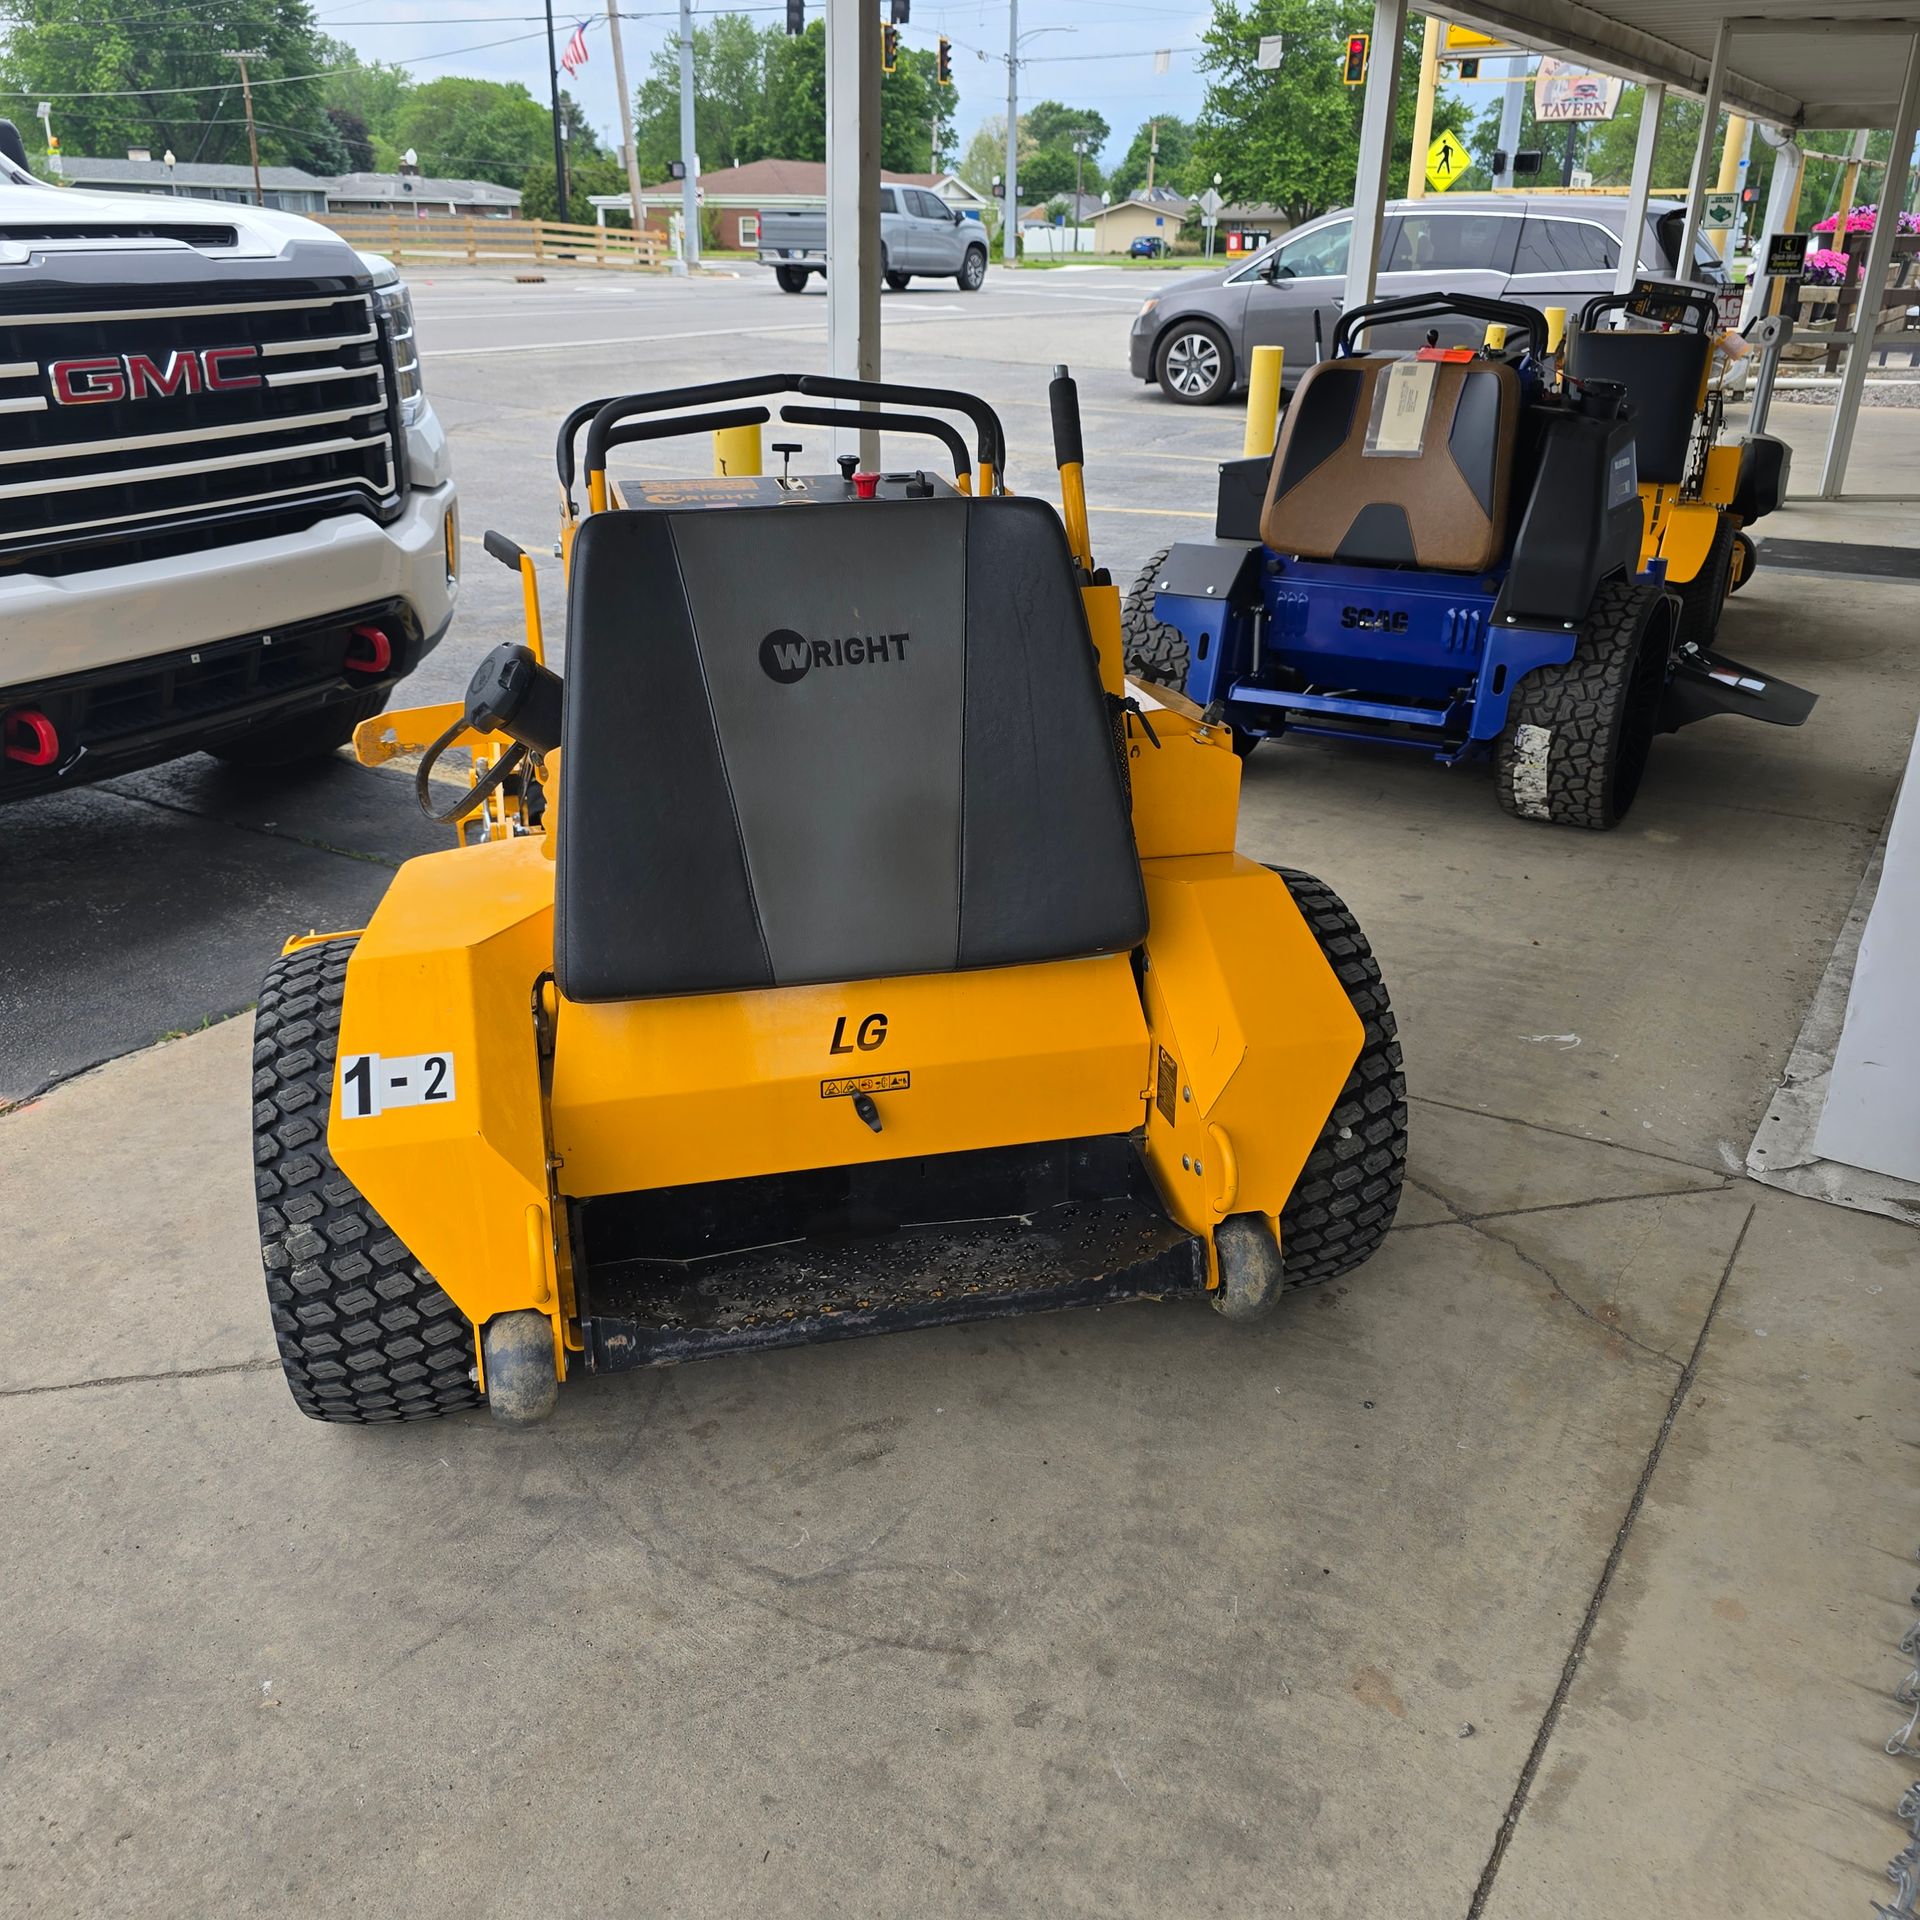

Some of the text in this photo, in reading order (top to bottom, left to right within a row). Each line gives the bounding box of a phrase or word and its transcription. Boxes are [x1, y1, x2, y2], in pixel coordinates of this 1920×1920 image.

[1541, 101, 1607, 118] TAVERN
[1717, 297, 1742, 319] AG
[48, 346, 262, 405] GMC
[1340, 606, 1409, 634] SCAG
[764, 632, 910, 678] WRIGHT
[829, 1013, 888, 1055] LG
